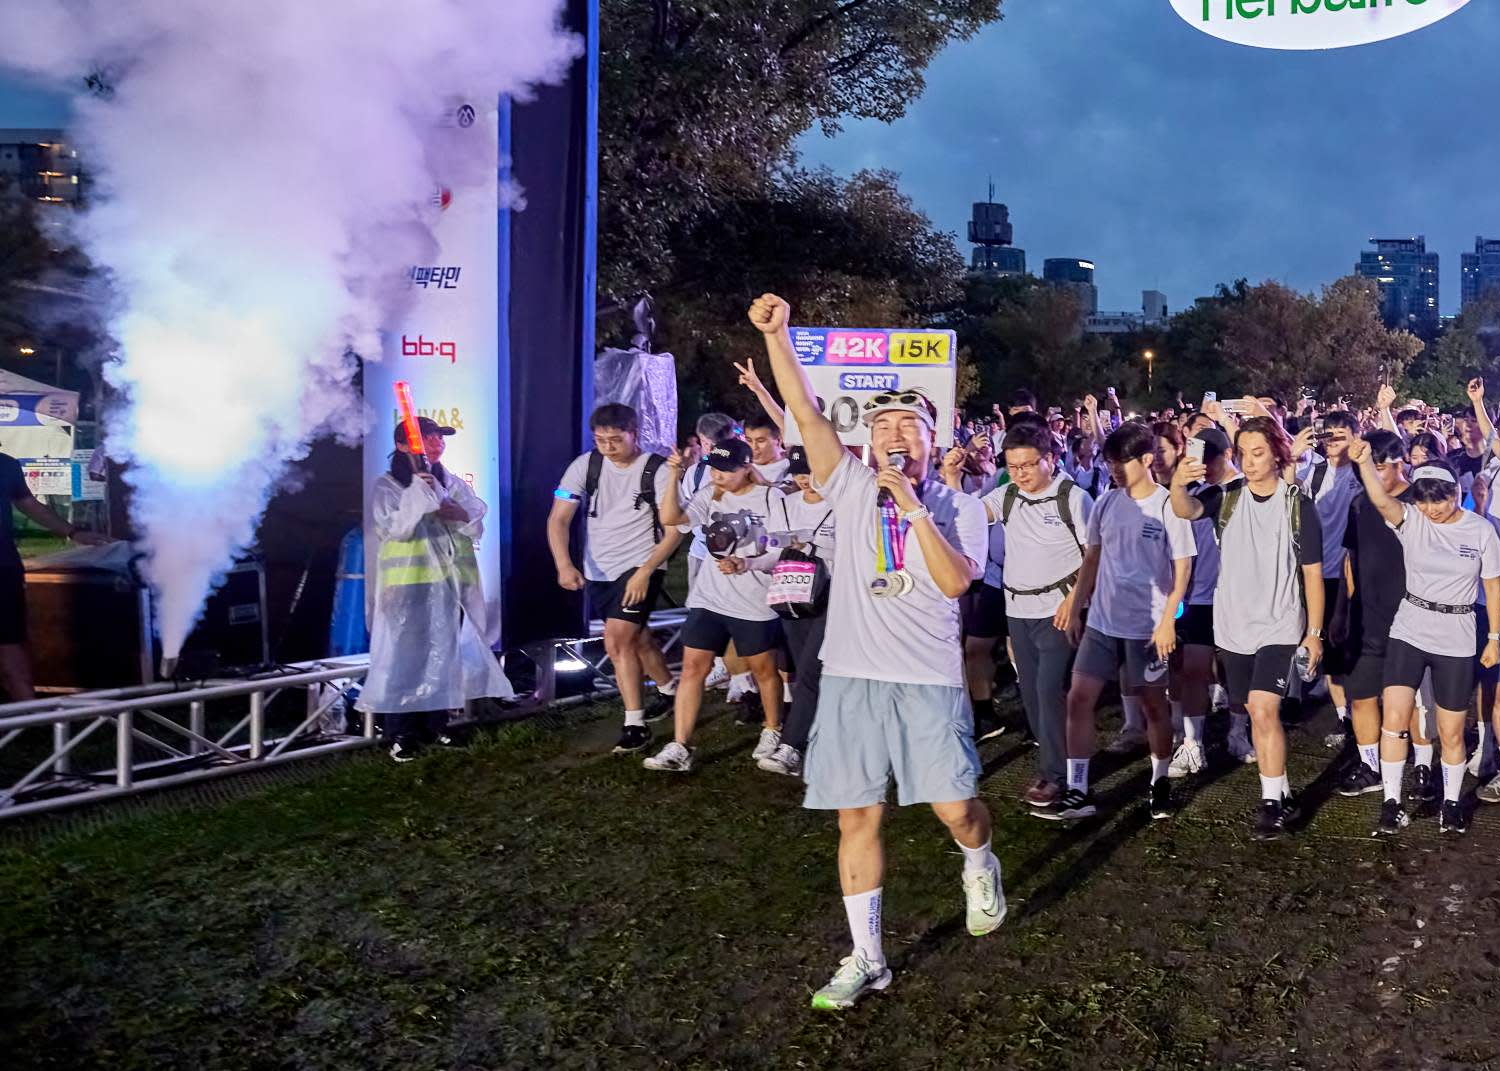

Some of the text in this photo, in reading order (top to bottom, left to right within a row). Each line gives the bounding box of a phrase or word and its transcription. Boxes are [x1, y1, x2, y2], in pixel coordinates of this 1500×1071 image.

[829, 337, 884, 358] 42K
[897, 339, 942, 358] 15K
[843, 374, 894, 389] START
